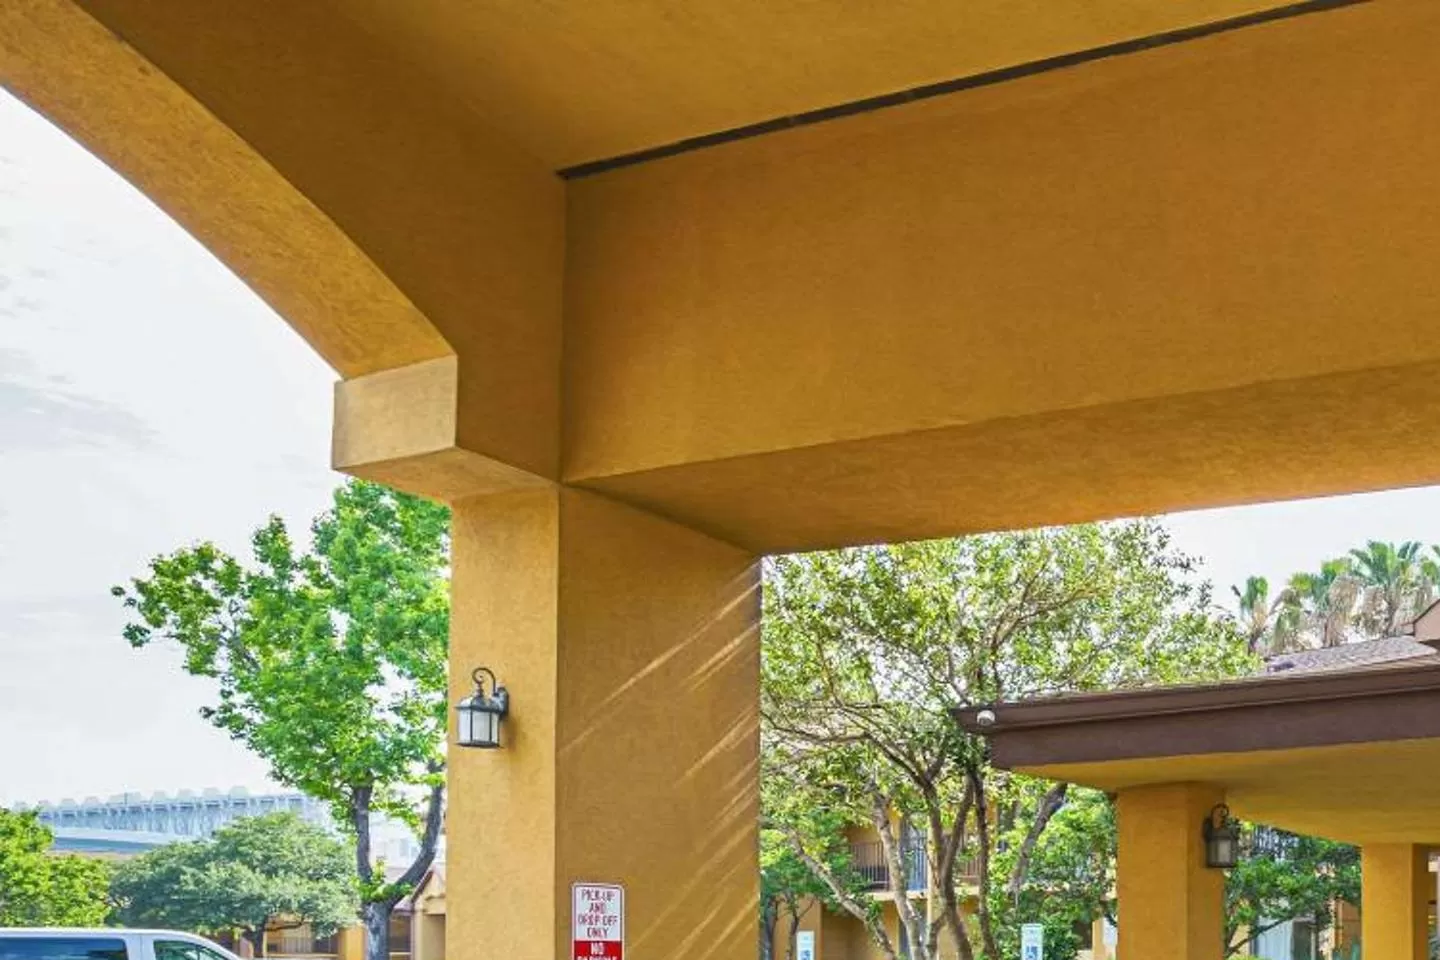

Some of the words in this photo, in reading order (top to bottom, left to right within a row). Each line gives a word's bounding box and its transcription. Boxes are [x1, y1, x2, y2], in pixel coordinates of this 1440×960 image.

[589, 902, 607, 914] AND
[578, 914, 600, 926] DROP
[603, 915, 618, 926] OFF
[587, 927, 609, 938] ONLY
[591, 942, 605, 955] NO
